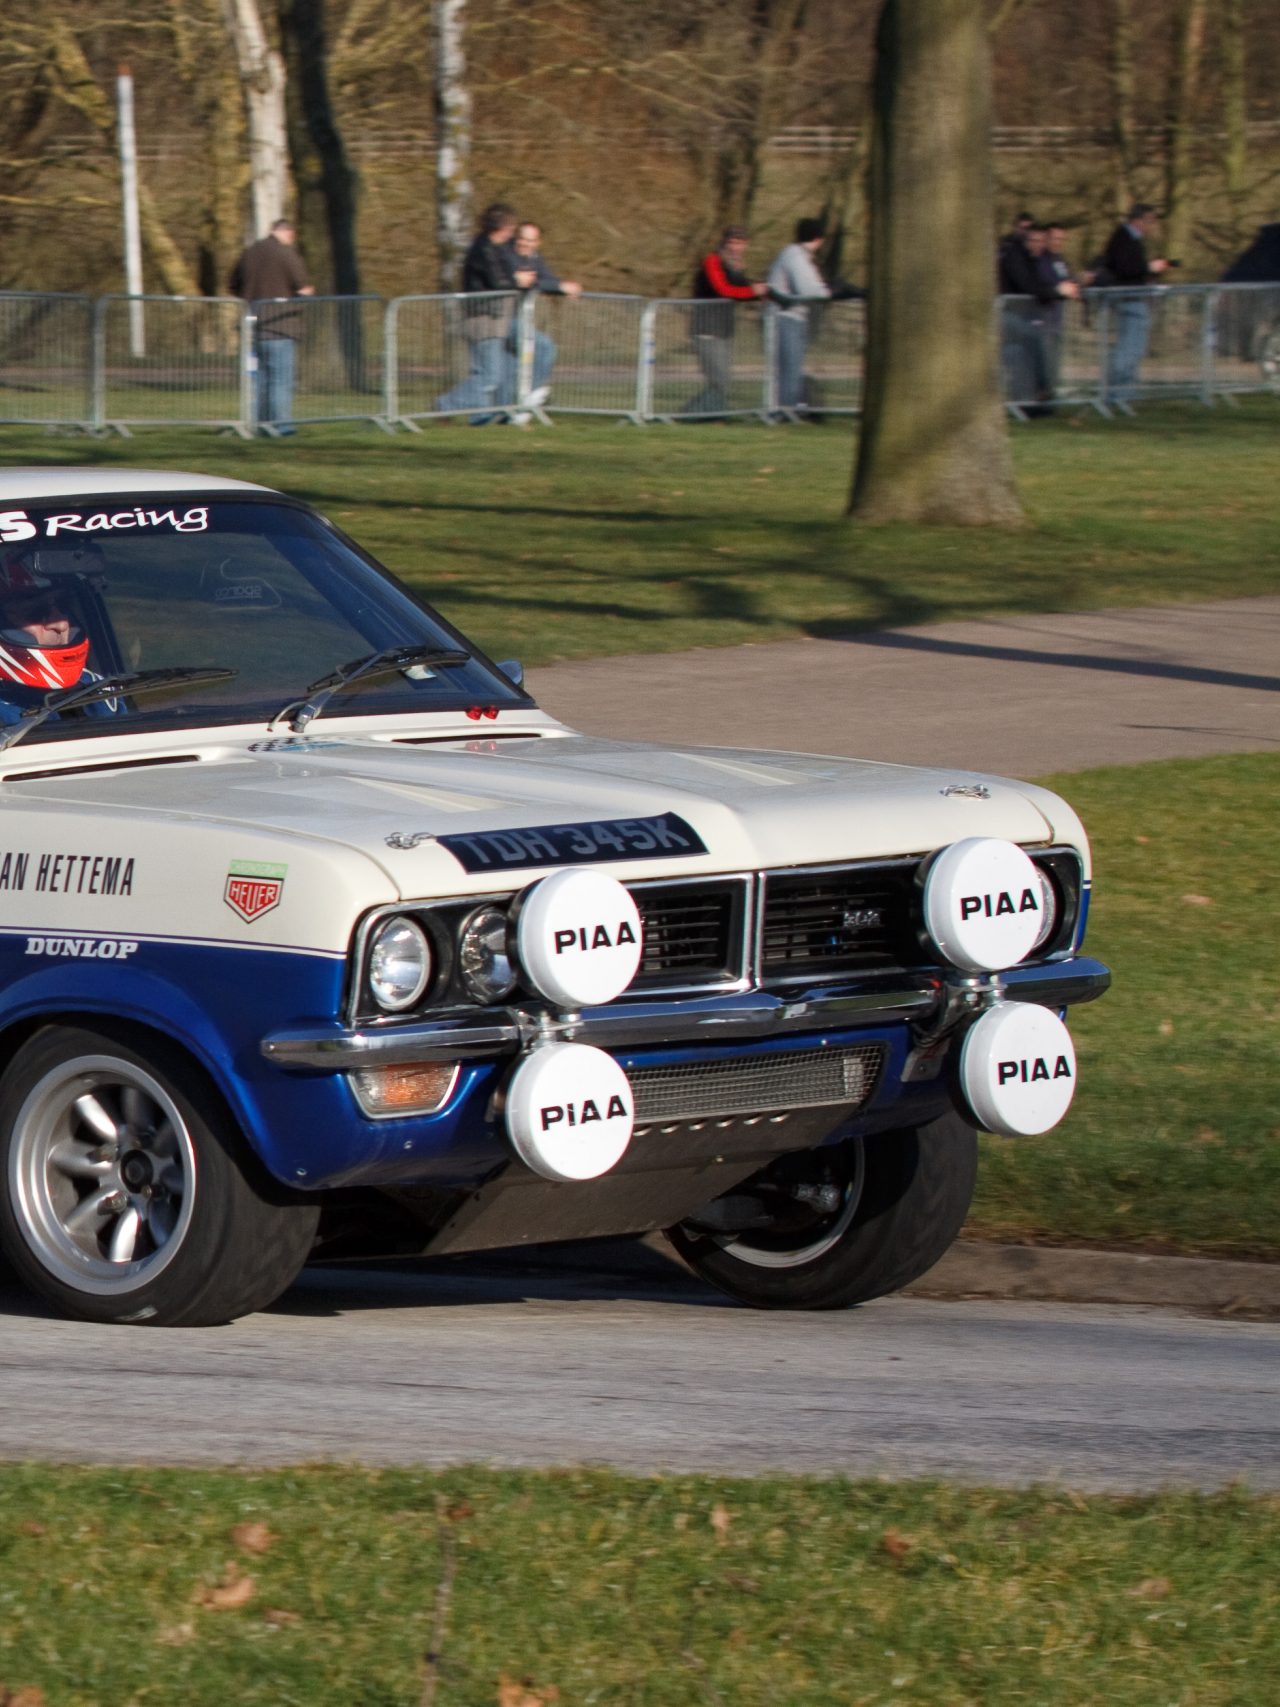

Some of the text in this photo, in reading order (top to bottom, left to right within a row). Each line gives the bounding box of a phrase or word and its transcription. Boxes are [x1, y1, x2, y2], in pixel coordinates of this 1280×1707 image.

[44, 507, 209, 537] Racing
[449, 819, 691, 863] TDH 345K
[35, 854, 135, 896] HETTEMA
[230, 883, 276, 913] HEUER
[960, 887, 1039, 921] PIAA
[25, 937, 138, 959] DUNLOP
[554, 921, 636, 954] PIAA
[998, 1055, 1072, 1085] PIAA
[540, 1095, 627, 1131] PIAA
